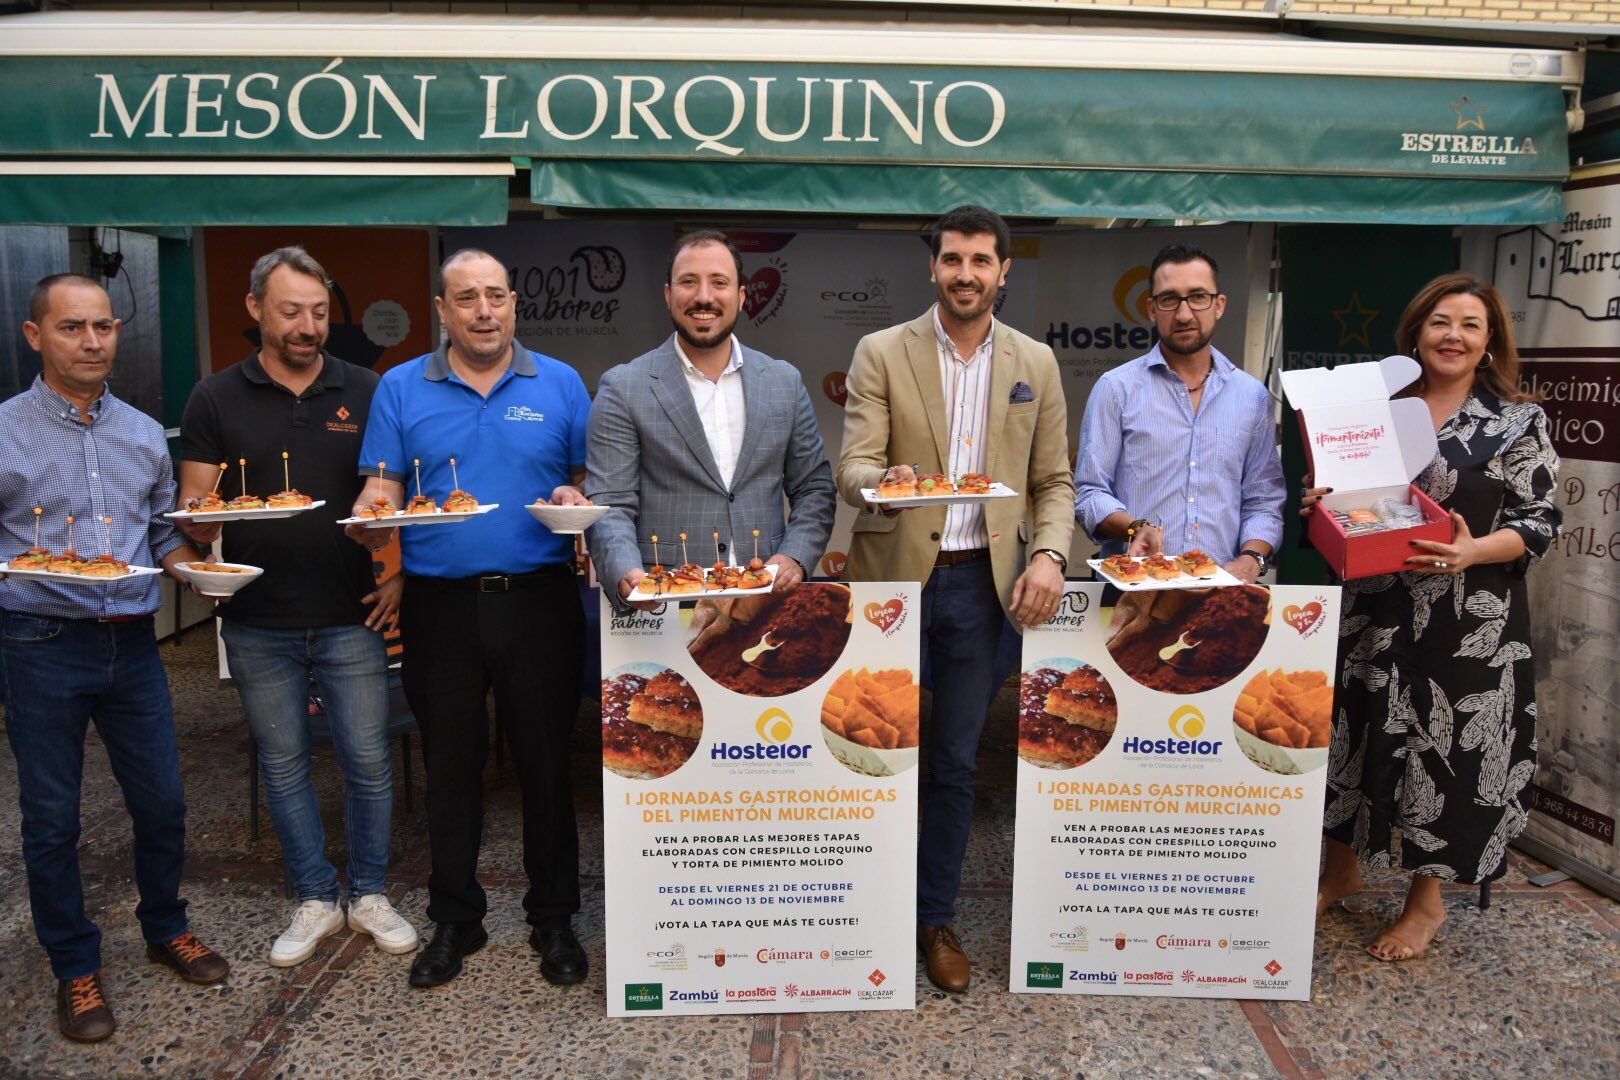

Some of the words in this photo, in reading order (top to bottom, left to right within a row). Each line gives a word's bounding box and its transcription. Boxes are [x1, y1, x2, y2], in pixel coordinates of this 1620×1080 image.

[90, 57, 437, 141] MESÓN
[479, 74, 1006, 155] LORQUINO
[1400, 133, 1537, 155] ESTRELLA
[1431, 154, 1449, 164] DE
[1451, 155, 1506, 166] LEVANTE
[1560, 211, 1612, 233] Mesón
[820, 291, 868, 302] eco
[515, 288, 620, 323] sabores
[516, 327, 553, 336] EGIÓN
[557, 328, 571, 336] DE
[575, 326, 618, 336] MURCIA
[1047, 323, 1158, 350] Hostel
[611, 615, 664, 630] sabores
[711, 743, 812, 759] Hostelor
[1123, 737, 1223, 755] Hostelor
[626, 792, 630, 806] I
[636, 790, 734, 807] JORNADAS
[738, 784, 896, 806] GASTRONÓMICAS
[1038, 781, 1044, 795] I
[1048, 781, 1142, 797] JORNADAS
[1148, 781, 1304, 801] GASTRONÓMICAS
[1054, 798, 1084, 813] DEL
[1090, 796, 1180, 815] PIMENTÓN
[1184, 800, 1282, 817] MURCIANO
[642, 808, 674, 824] DEL
[680, 803, 772, 823] PIMENTÓN
[778, 806, 876, 821] MURCIANO
[1544, 797, 1564, 815] 968
[1598, 821, 1612, 837] 76
[1064, 824, 1086, 832] VEN
[1090, 824, 1096, 832] A
[1100, 824, 1146, 834] PROBAR
[1150, 826, 1170, 834] LAS
[1174, 826, 1224, 835] MEJORES
[1228, 827, 1264, 836] TAPAS
[654, 836, 678, 844] VEN
[682, 836, 690, 844] A
[692, 835, 740, 844] PROBAR
[744, 834, 764, 843] LAS
[768, 833, 820, 842] MEJORES
[824, 833, 860, 842] TAPAS
[1050, 835, 1124, 845] ELABORADAS
[1128, 837, 1152, 846] CON
[1156, 838, 1214, 847] CRESPILLO
[1218, 839, 1276, 849] LORQUINO
[642, 847, 718, 857] ELABORADAS
[722, 847, 746, 856] CON
[750, 846, 810, 855] CRESPILLO
[814, 845, 872, 855] LORQUINO
[1078, 848, 1086, 856] Y
[1088, 848, 1124, 857] TORTA
[1128, 849, 1142, 857] DE
[1146, 849, 1200, 859] PIMIENTO
[1204, 851, 1246, 860] MOLIDO
[672, 861, 678, 869] Y
[682, 860, 720, 869] TORTA
[724, 860, 738, 868] DE
[742, 859, 796, 868] PIMIENTO
[800, 858, 844, 867] MOLIDO
[1064, 871, 1100, 880] DESDE
[1104, 872, 1116, 880] EL
[1120, 872, 1168, 881] VIERNES
[1172, 873, 1182, 882] 21
[1186, 874, 1200, 882] DE
[1204, 874, 1254, 884] OCTUBRE
[658, 885, 696, 894] DESDE
[700, 885, 712, 893] EL
[716, 884, 764, 893] VIERNES
[768, 884, 778, 892] 21
[784, 883, 798, 892] DE
[800, 882, 852, 892] OCTUBRE
[1076, 883, 1090, 891] AL
[1092, 884, 1146, 893] DOMINGO
[1148, 885, 1158, 893] 13
[1162, 885, 1176, 893] DE
[1180, 886, 1246, 895] NOVIEMBRE
[670, 898, 684, 907] AL
[688, 897, 742, 906] DOMINGO
[746, 896, 756, 905] 13
[760, 896, 774, 905] DE
[778, 895, 844, 904] NOVIEMBRE
[1060, 904, 1092, 914] ¡VOTA
[1096, 905, 1110, 913] LA
[1114, 905, 1144, 914] TAPA
[1146, 906, 1170, 916] QUE
[1174, 906, 1198, 916] MÁS
[1202, 908, 1214, 916] TE
[1218, 908, 1258, 917] GUSTE!
[656, 921, 690, 931] ¡VOTA
[694, 920, 708, 929] LA
[710, 919, 742, 928] TAPA
[746, 919, 770, 929] QUE
[774, 917, 798, 927] MÁS
[800, 918, 814, 927] TE
[818, 917, 858, 926] GUSTE!
[1156, 934, 1211, 949] Cámara
[757, 948, 813, 964] Cámara
[1069, 970, 1119, 982] Zambú
[1124, 971, 1133, 980] la
[1135, 971, 1174, 982] pastora
[1197, 975, 1247, 984] ALBARRACÍN
[669, 989, 719, 1001] Zambú
[725, 989, 735, 997] la
[737, 987, 777, 998] pastora
[800, 988, 851, 997] ALBARRACÍN
